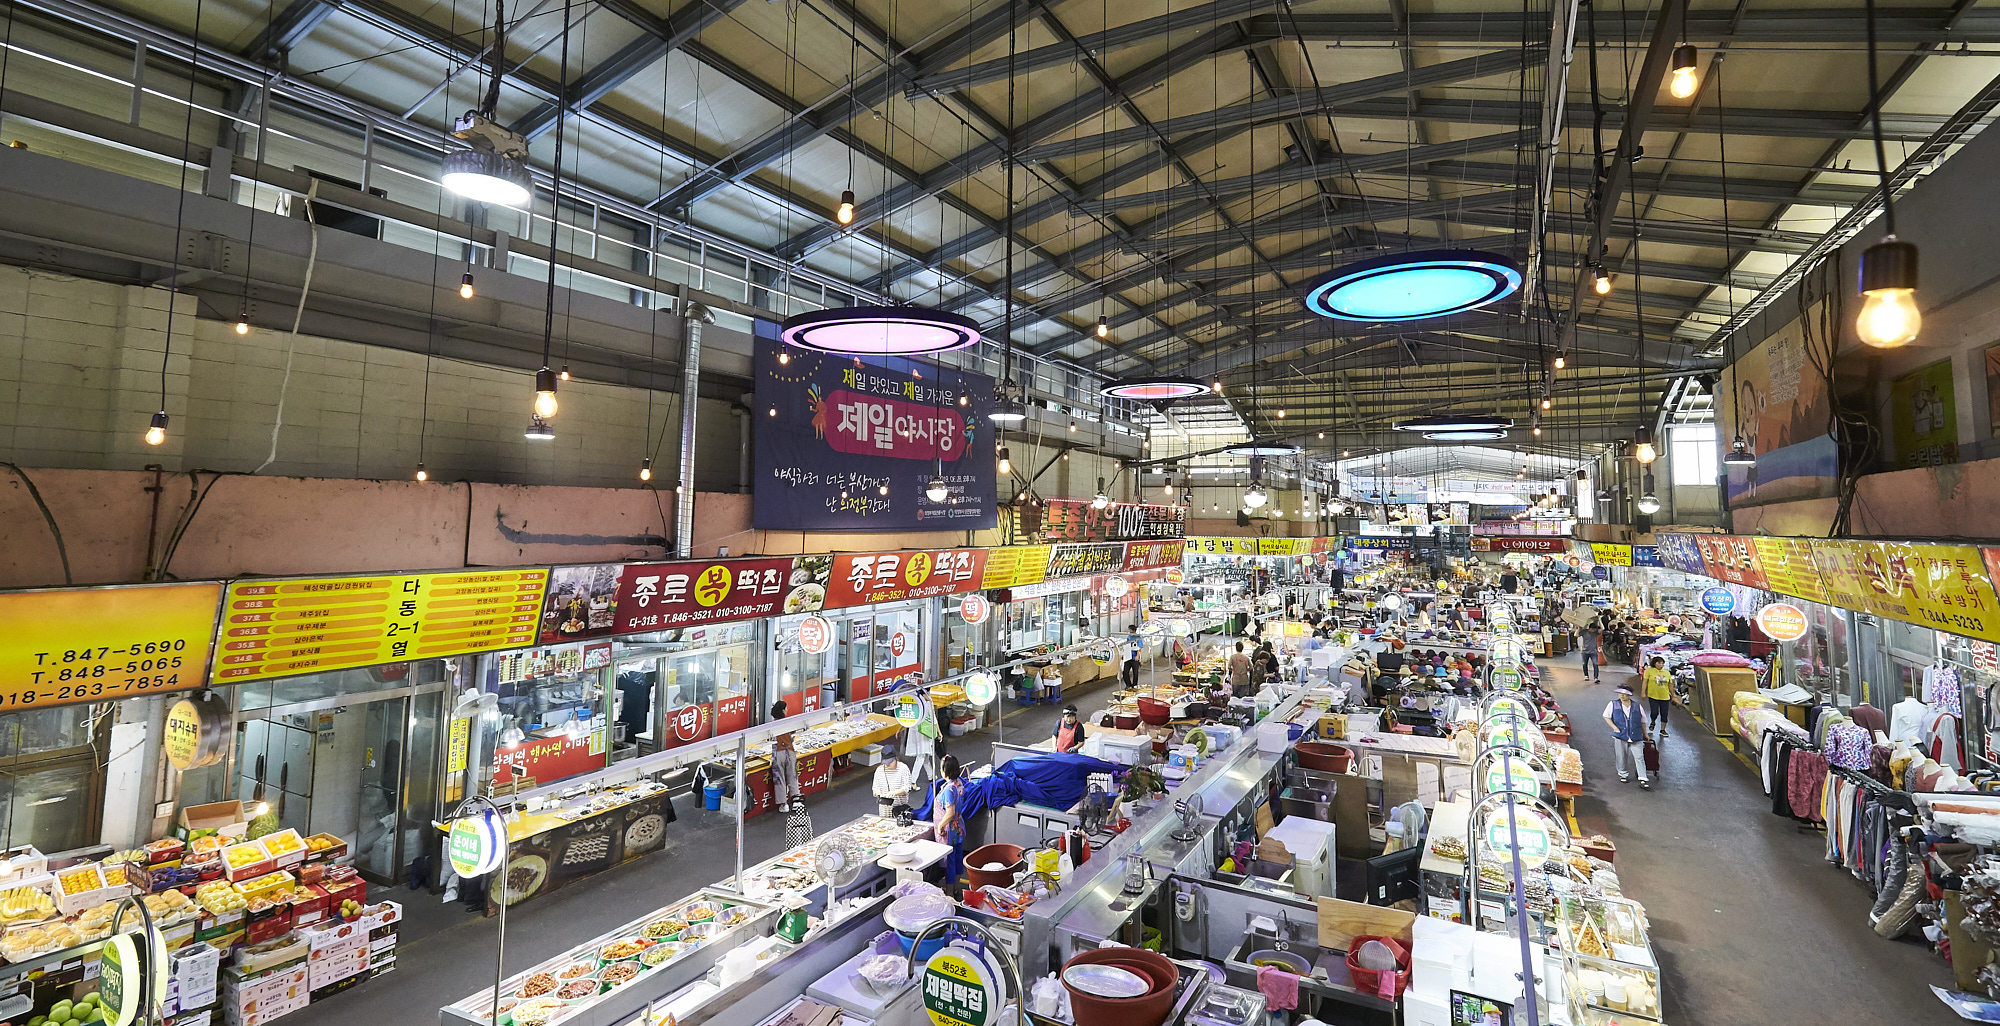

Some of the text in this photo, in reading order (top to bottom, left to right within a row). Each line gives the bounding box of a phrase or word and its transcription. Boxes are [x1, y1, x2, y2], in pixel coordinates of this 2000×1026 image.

[843, 368, 866, 390] 제일
[870, 376, 900, 396] 맛있고
[903, 381, 924, 401] 제일
[774, 468, 818, 487] 야식하러
[826, 472, 846, 489] 너는
[826, 496, 890, 516] 난 의정부간다!
[1118, 505, 1144, 537] 100%
[1187, 540, 1234, 552] 마당발
[1354, 538, 1389, 548] 태풍상회
[847, 555, 900, 592] 종로
[934, 552, 976, 583] 떡집
[632, 569, 782, 608] 종로 복 떡집
[908, 584, 956, 598] 010-3100-7187
[628, 614, 658, 628] 다-31호
[716, 603, 774, 618] 010-3100-7187
[1919, 607, 1984, 632] T.844-5233
[35, 638, 186, 666] T.847-5690
[893, 636, 903, 653] 떡
[32, 656, 182, 684] T.848-5065
[289, 659, 318, 669] 대지슈퍼
[170, 718, 197, 739] 대지슈퍼
[680, 709, 697, 734] 떡
[454, 834, 478, 852] 준이네
[942, 961, 967, 978] 북52호
[925, 972, 983, 1012] 제일떡집
[957, 1008, 971, 1019] 전문)
